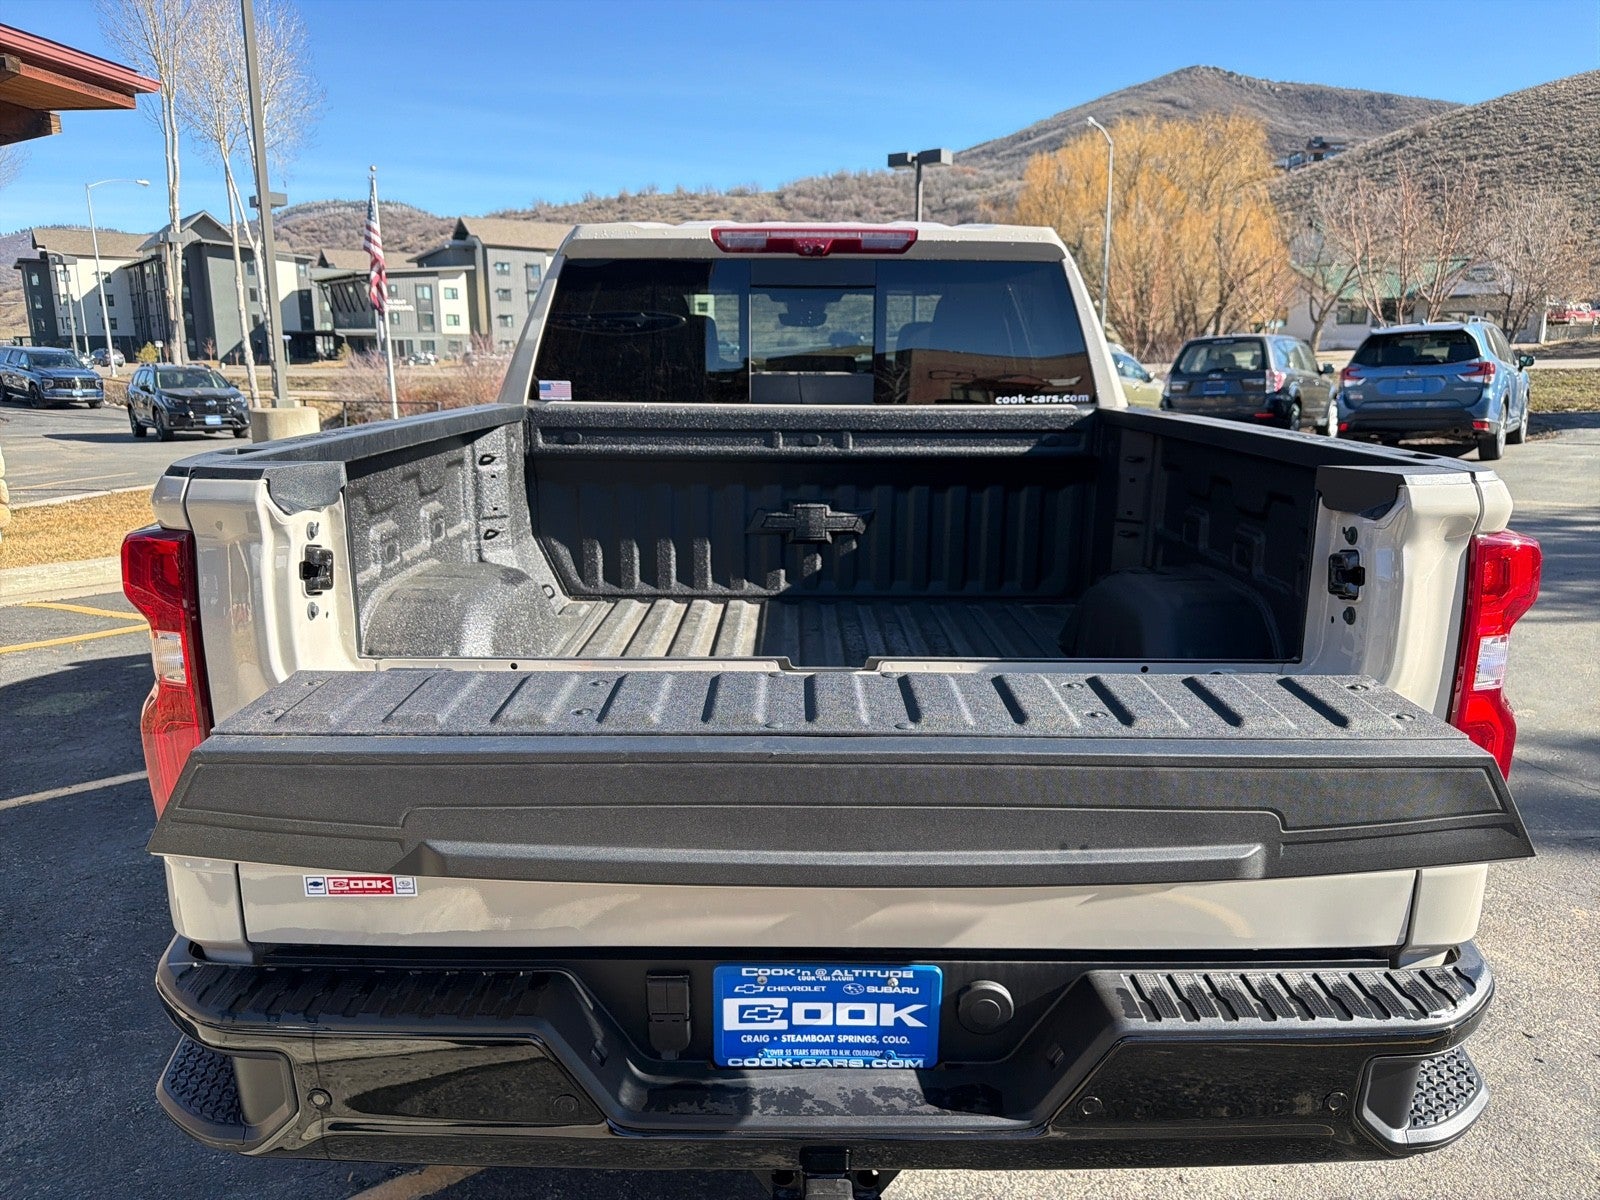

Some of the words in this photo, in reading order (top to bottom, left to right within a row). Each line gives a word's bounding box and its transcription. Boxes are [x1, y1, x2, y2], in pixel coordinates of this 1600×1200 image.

[995, 394, 1089, 404] cook-cars.com
[328, 879, 392, 890] COOK
[831, 970, 914, 978] ALTITUDE
[866, 986, 920, 995] SUBARU
[723, 997, 928, 1031] COOK
[741, 1034, 770, 1043] CRAIG
[781, 1034, 835, 1043] STEAMBOAT
[837, 1034, 880, 1045] SPRINGS,
[882, 1035, 910, 1044] COLO.
[794, 1049, 809, 1057] YEARS
[810, 1049, 829, 1057] SERVICE
[831, 1049, 838, 1057] TO
[727, 1057, 924, 1069] COOK-CARS.COM
